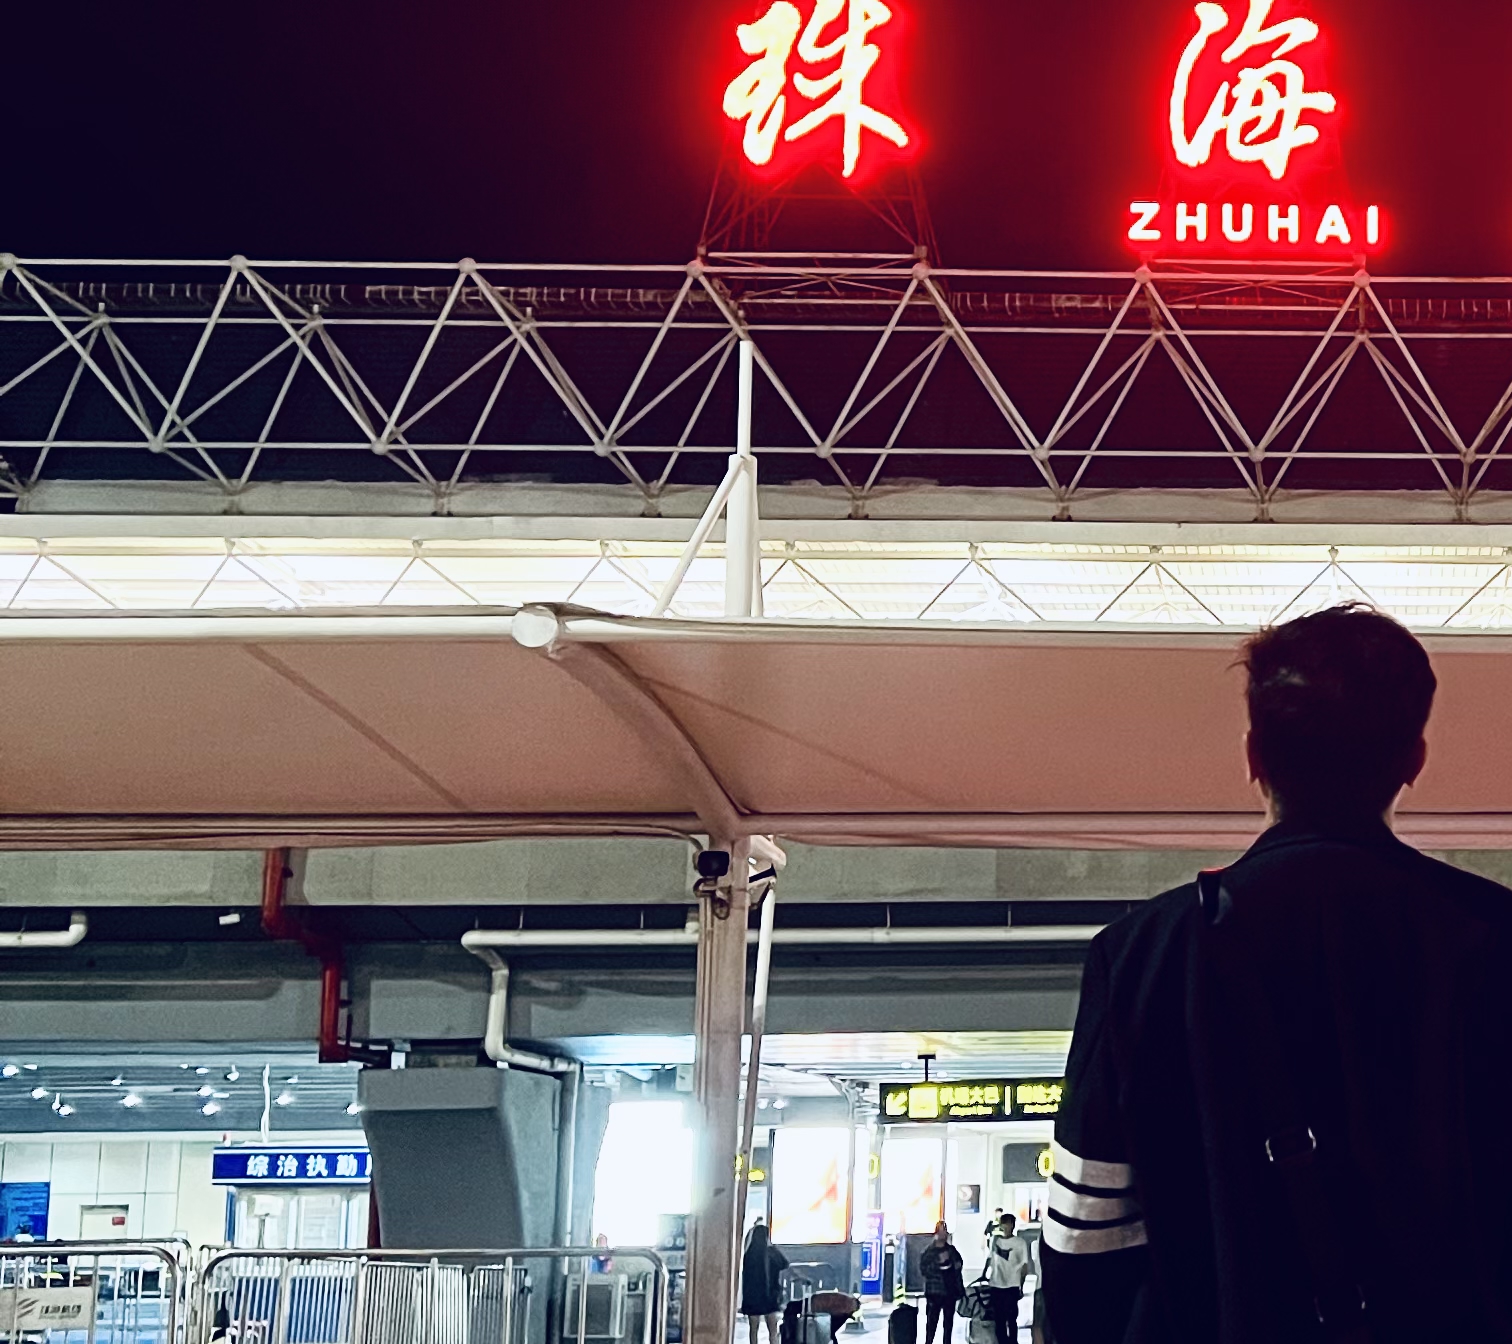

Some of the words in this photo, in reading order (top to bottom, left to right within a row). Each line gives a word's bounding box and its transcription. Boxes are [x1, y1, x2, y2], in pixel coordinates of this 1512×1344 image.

[1127, 201, 1380, 244] ZHUHAI
[246, 1153, 373, 1177] 综治执勤
[1036, 1149, 1056, 1178] 0
